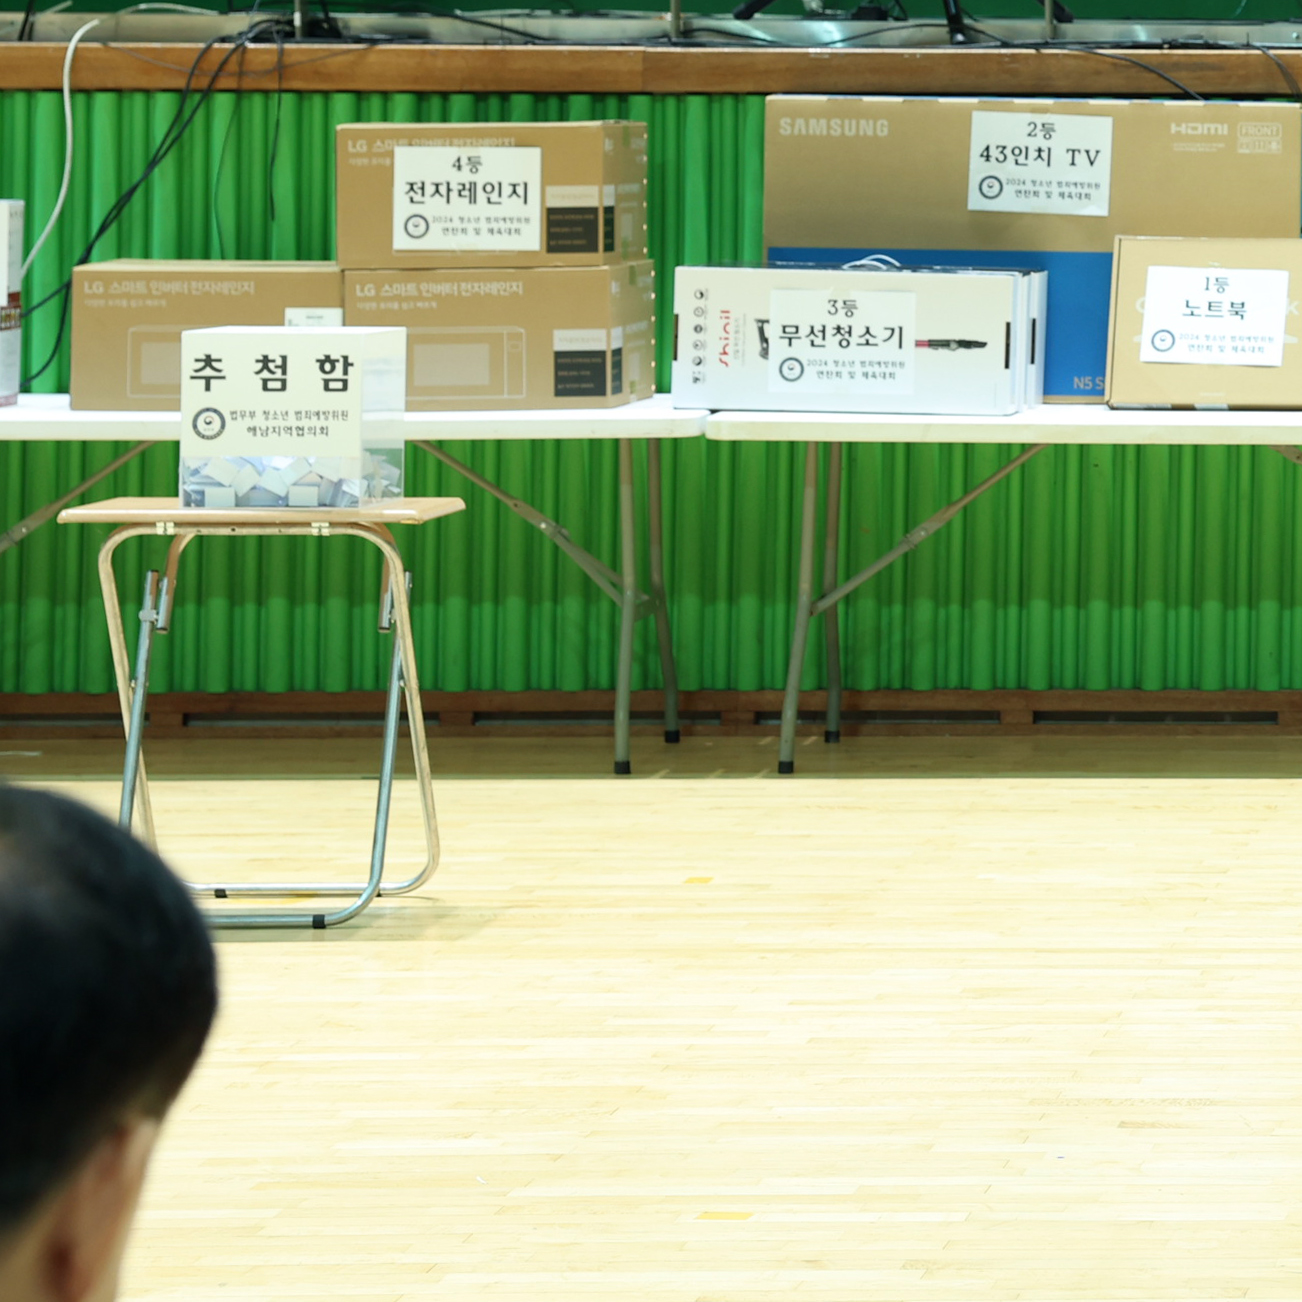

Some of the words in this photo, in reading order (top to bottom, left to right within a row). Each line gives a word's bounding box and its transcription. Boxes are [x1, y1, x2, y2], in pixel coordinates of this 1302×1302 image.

[779, 117, 889, 136] SAMSUNG
[1027, 122, 1057, 140] 2등
[1170, 123, 1229, 136] HDMI
[1242, 125, 1278, 136] FRONT
[348, 139, 367, 153] LG
[452, 155, 483, 175] 4등
[979, 145, 1052, 168] 43인치
[1066, 148, 1101, 167] TV
[1005, 178, 1027, 186] 2024
[404, 181, 529, 206] 전자레인지
[84, 280, 104, 295] LG
[108, 280, 148, 295] 스마트
[356, 284, 376, 297] LG
[381, 283, 418, 297] 스마트
[420, 282, 457, 297] 인버터
[459, 281, 524, 296] 전자레인지
[1204, 276, 1230, 294] 1등
[827, 299, 858, 318] 3등
[1182, 299, 1247, 321] 노트북
[779, 324, 904, 349] 무선청소기
[1073, 376, 1092, 390] N5
[229, 410, 257, 422] 법무부
[262, 410, 290, 422] 청소년
[294, 410, 349, 422] 범죄예방위원
[246, 425, 330, 438] 해남지역협의회
